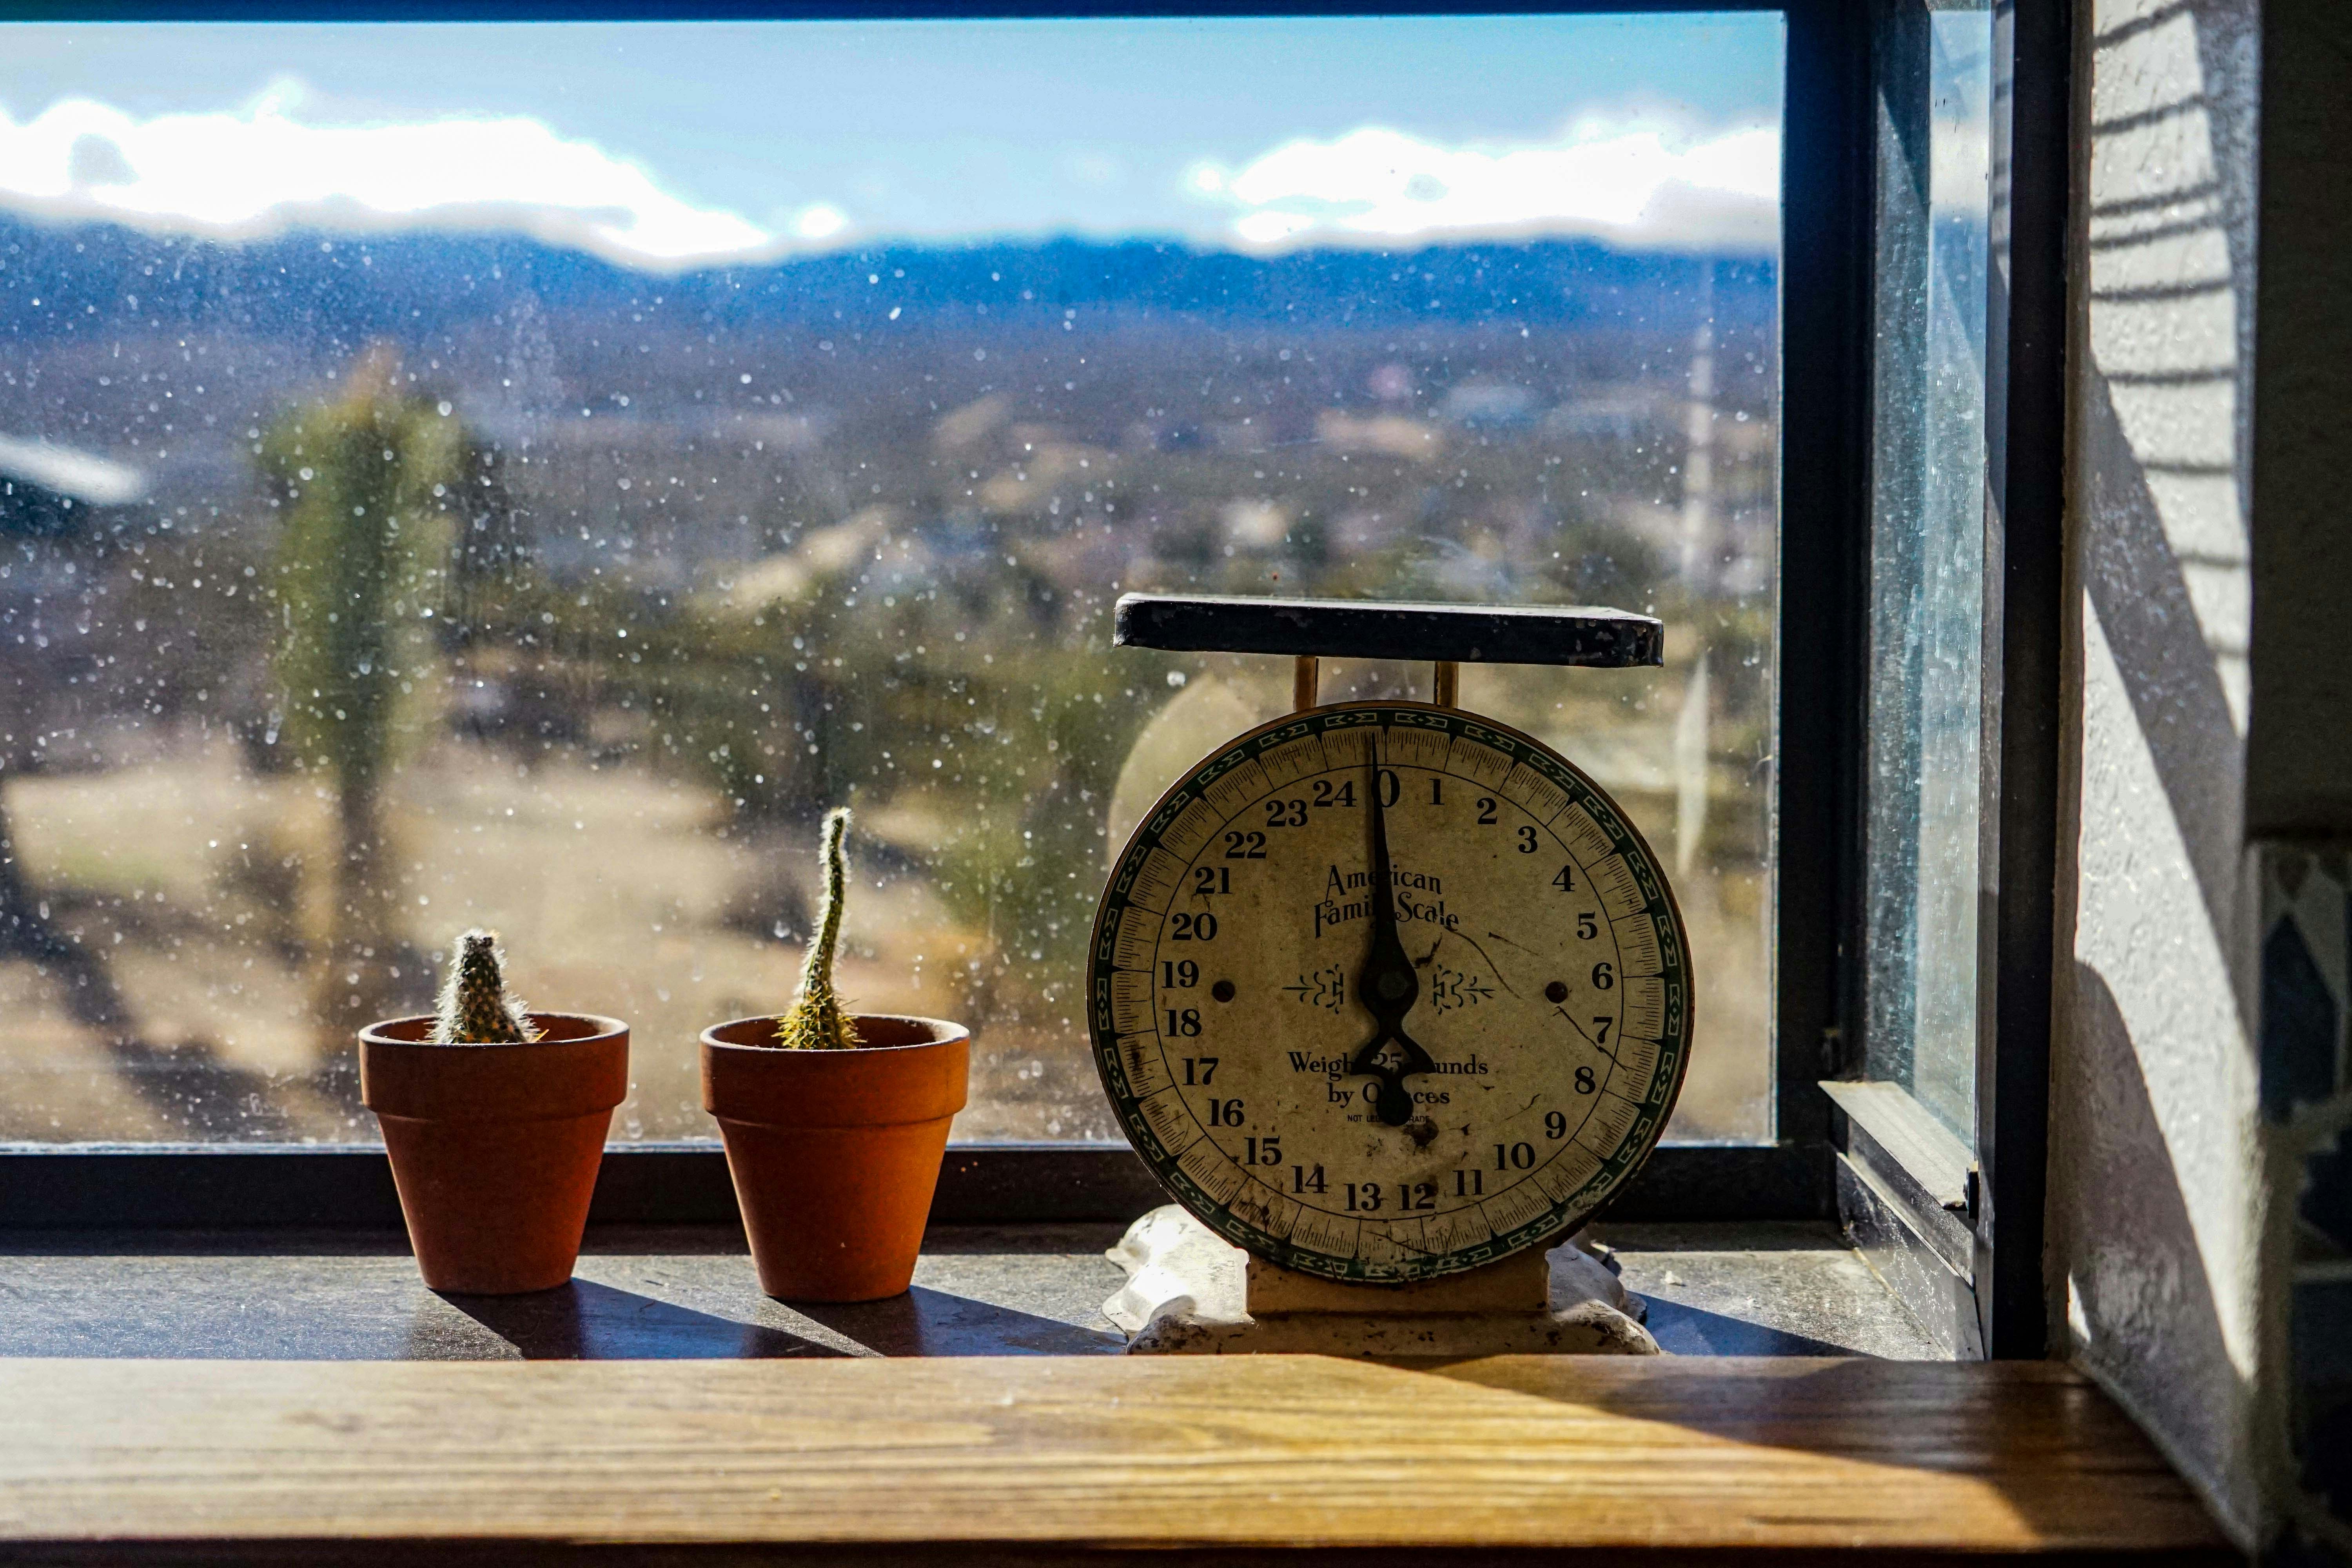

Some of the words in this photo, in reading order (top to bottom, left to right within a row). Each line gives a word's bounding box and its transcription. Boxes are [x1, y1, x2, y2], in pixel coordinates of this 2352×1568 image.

[1313, 780, 1357, 807] 24
[1371, 769, 1400, 808] 0
[1429, 779, 1445, 805] 1
[1266, 800, 1308, 827] 23
[1477, 798, 1497, 824] 2
[1225, 831, 1267, 858] 22
[1518, 826, 1537, 853] 3
[1194, 867, 1232, 895] 21
[1326, 864, 1443, 904] Ameican
[1552, 866, 1575, 892] 4
[1172, 913, 1217, 941] 20
[1314, 894, 1390, 938] Fami
[1394, 891, 1459, 931] Scale
[1577, 911, 1597, 940] 5
[1161, 960, 1199, 988] 19
[1592, 962, 1613, 990] 6
[1165, 1009, 1201, 1037] 18
[1593, 1017, 1613, 1044] 7
[1182, 1058, 1219, 1085] 17
[1420, 1054, 1489, 1074] unds
[1575, 1067, 1595, 1094] 8
[1327, 1083, 1355, 1109] by
[1362, 1083, 1450, 1105] Oces
[1207, 1099, 1244, 1127] 16
[1545, 1111, 1566, 1139] 9
[1244, 1136, 1282, 1166] 15
[1494, 1142, 1535, 1171] 10
[1291, 1165, 1329, 1194] 14
[1452, 1170, 1485, 1197] 11
[1343, 1183, 1381, 1212] 13
[1397, 1183, 1437, 1210] 12
